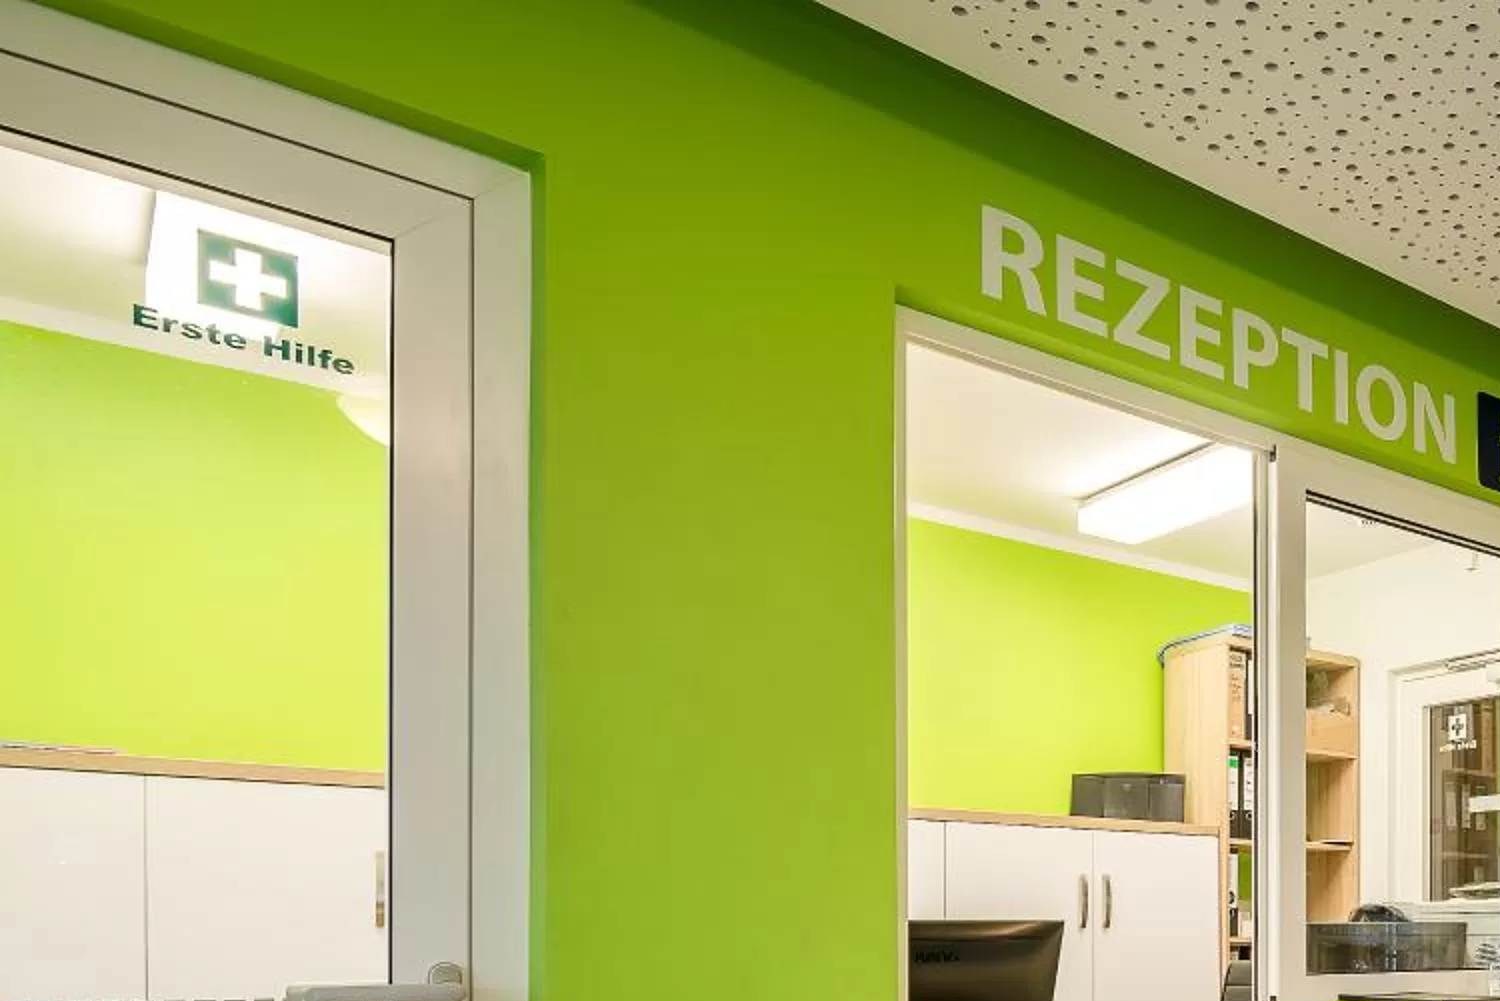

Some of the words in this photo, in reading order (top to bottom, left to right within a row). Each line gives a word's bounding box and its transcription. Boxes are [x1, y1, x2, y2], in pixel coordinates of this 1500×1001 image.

[133, 303, 247, 350] Erste
[263, 335, 355, 376] Hilfe
[980, 204, 1457, 465] REZEPTION
